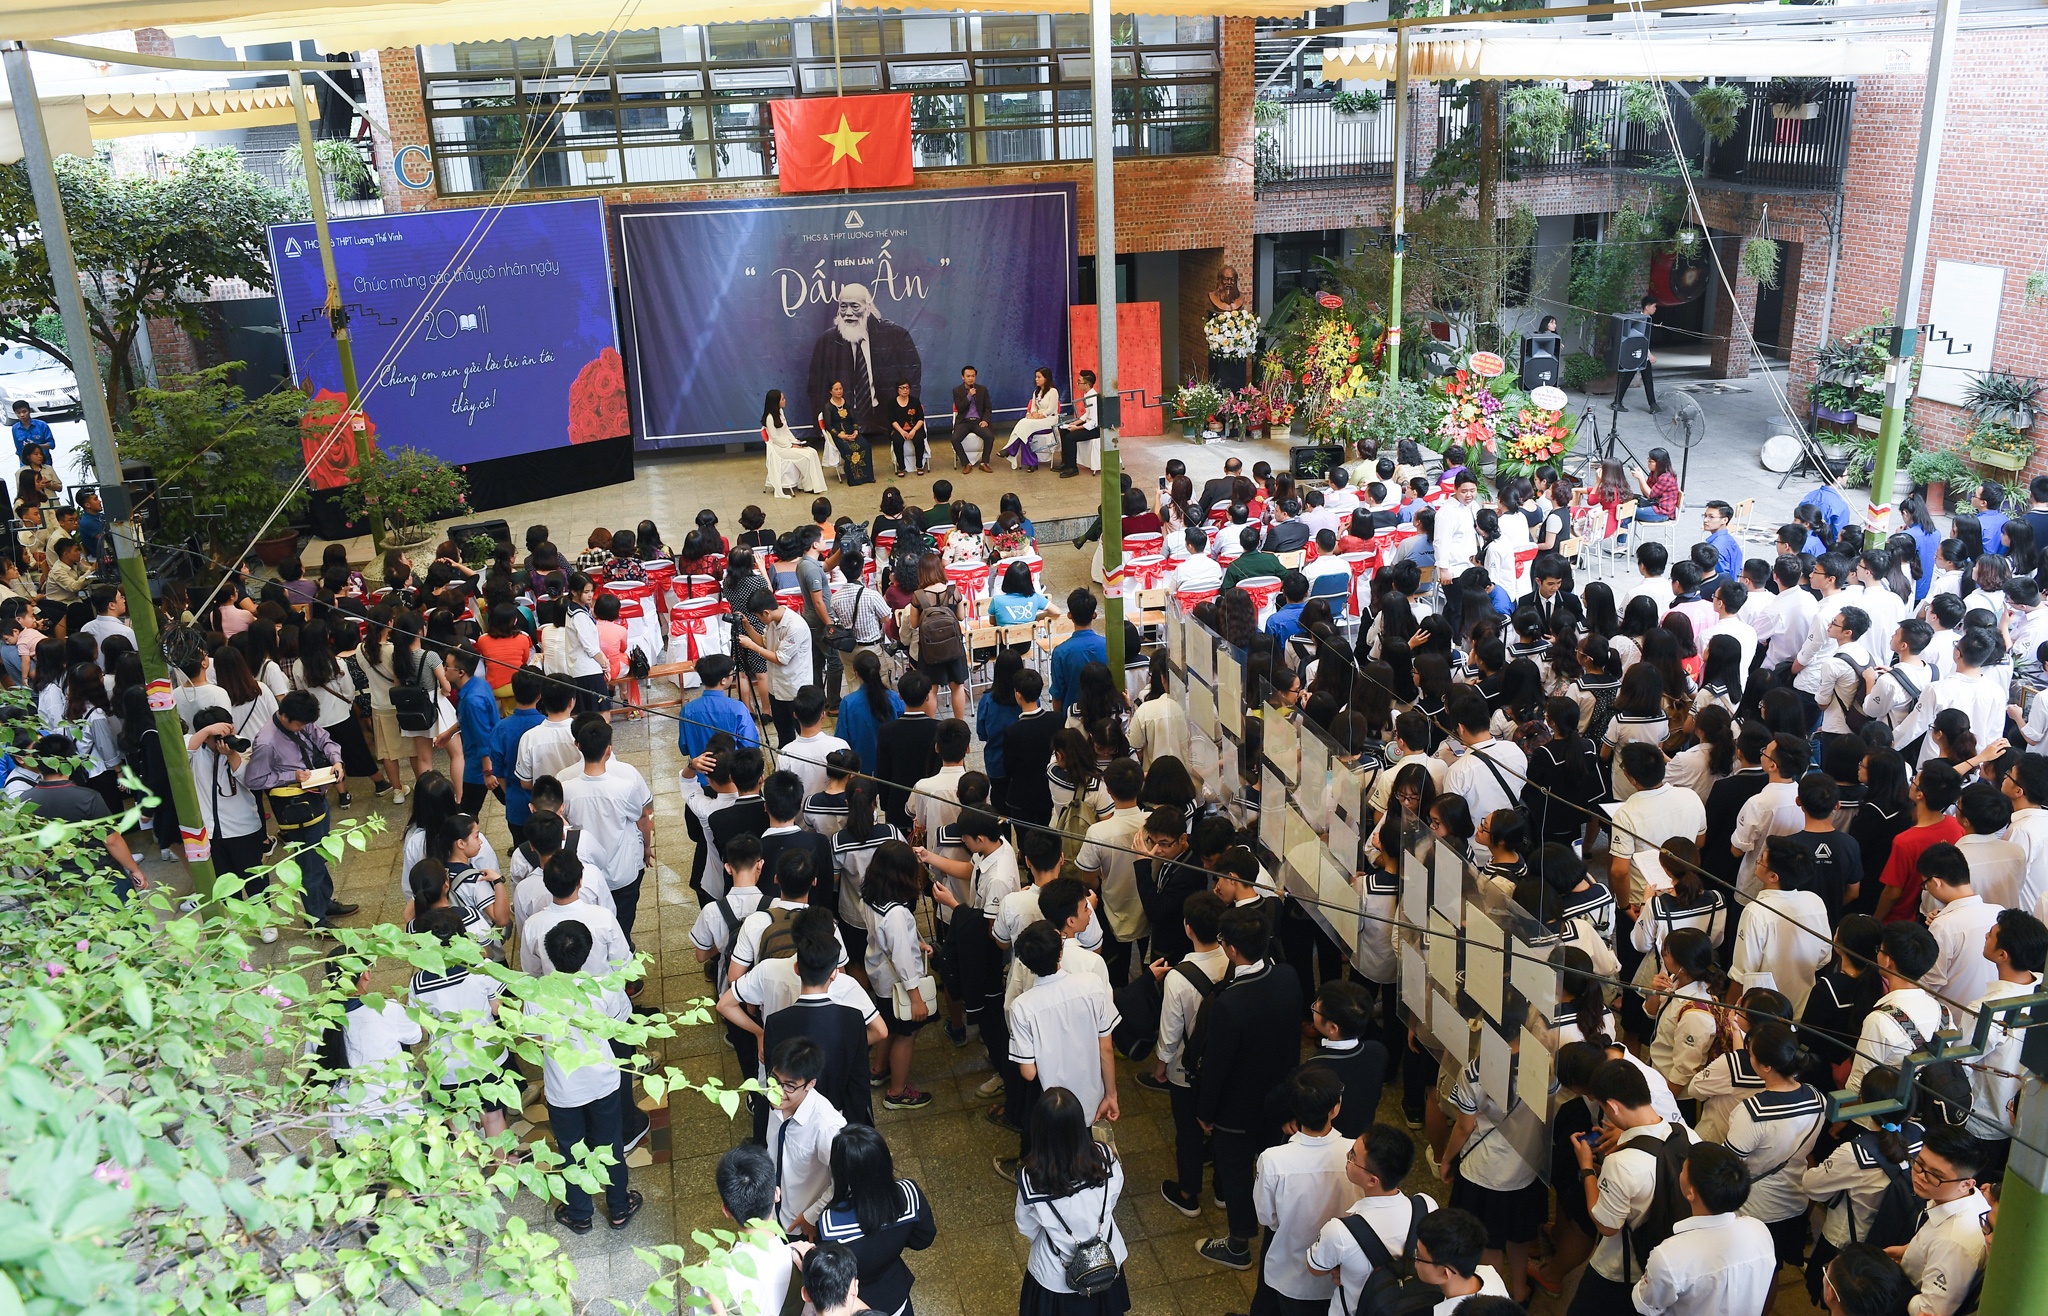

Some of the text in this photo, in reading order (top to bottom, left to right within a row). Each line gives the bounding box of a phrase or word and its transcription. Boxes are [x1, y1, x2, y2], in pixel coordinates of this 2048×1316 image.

[392, 144, 434, 190] C
[336, 236, 353, 247] THPT
[374, 231, 387, 243] Thế
[387, 231, 403, 242] Vinh
[802, 233, 821, 242] THCS
[830, 232, 846, 240] THPT
[875, 228, 889, 238] THẾ
[889, 229, 908, 237] VINH
[353, 275, 388, 293] Chúc
[390, 273, 427, 291] mừng
[429, 273, 451, 286] các
[498, 262, 529, 277] nhân
[530, 259, 560, 276] ngày
[771, 258, 844, 318] Dấu
[869, 238, 929, 302] Ấn
[379, 348, 556, 397] Chúng em xin gửi lời tri ân tới
